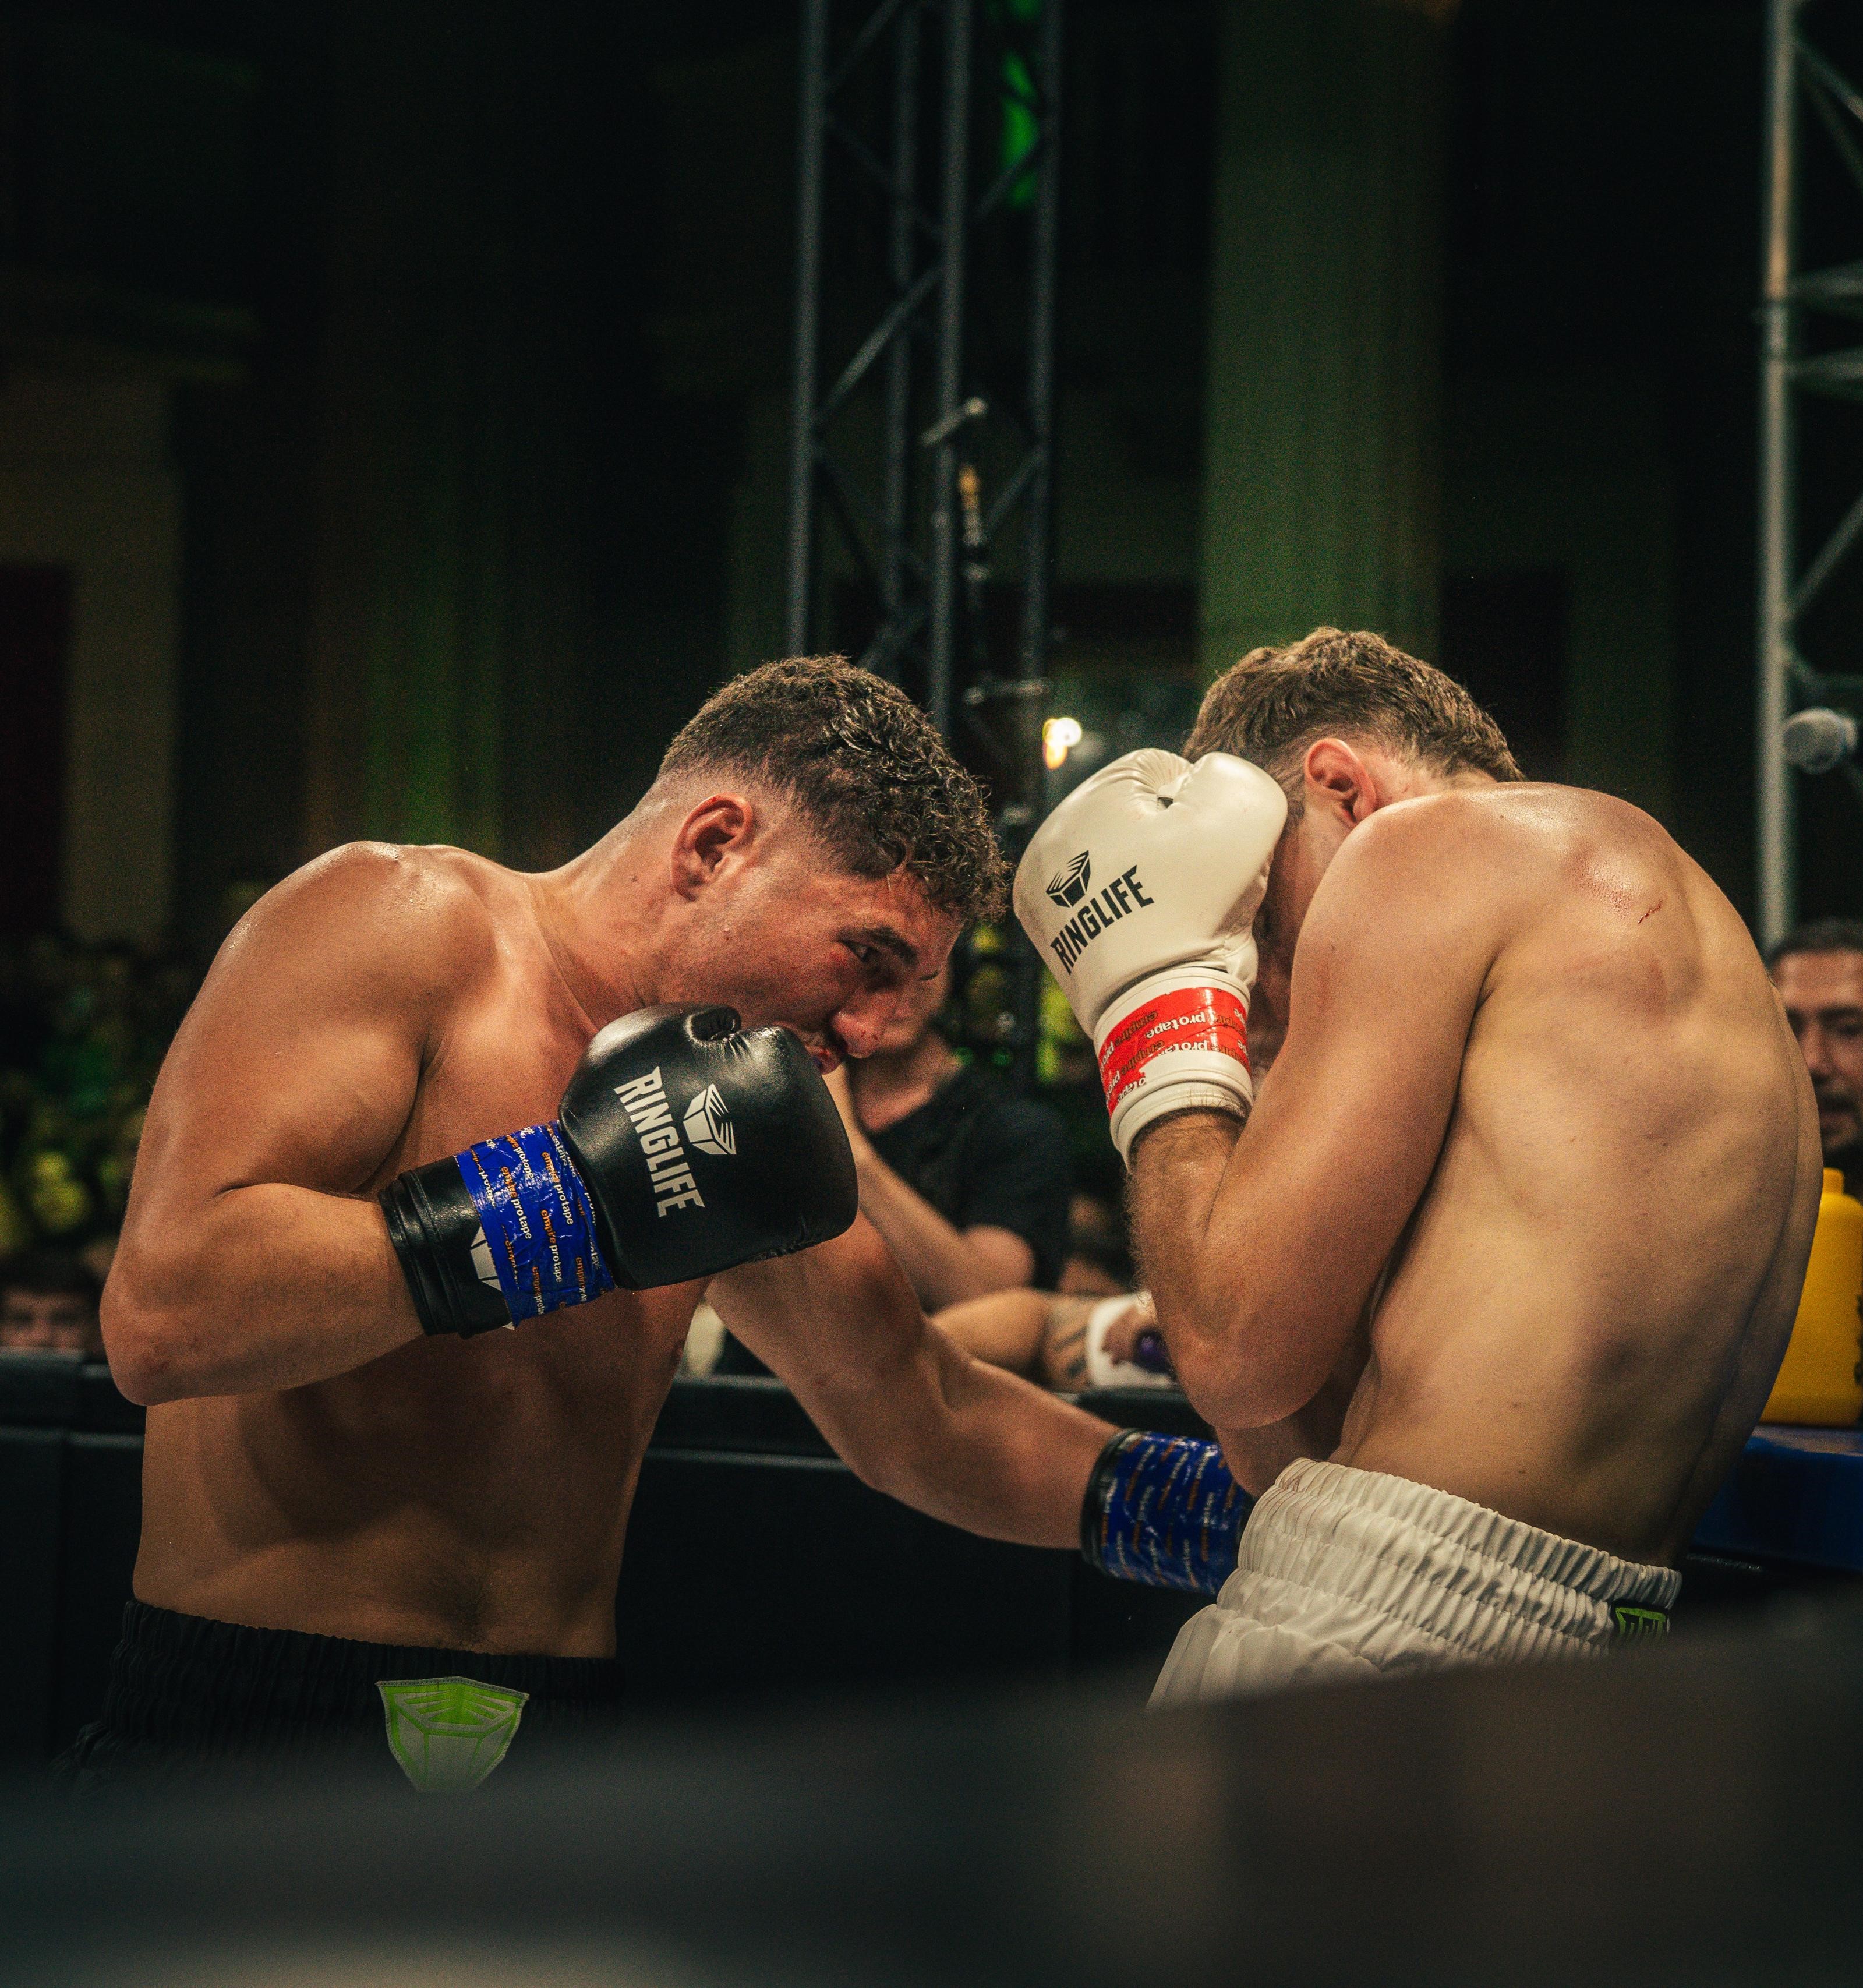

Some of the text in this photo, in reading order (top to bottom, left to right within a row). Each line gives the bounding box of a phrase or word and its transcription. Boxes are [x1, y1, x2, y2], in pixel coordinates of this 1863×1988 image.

[1050, 864, 1155, 976] RINGLIFE
[614, 1066, 705, 1217] RINGLIFE
[511, 1198, 532, 1240] protape
[553, 1184, 574, 1225] protape
[540, 1209, 563, 1283] empire protape
